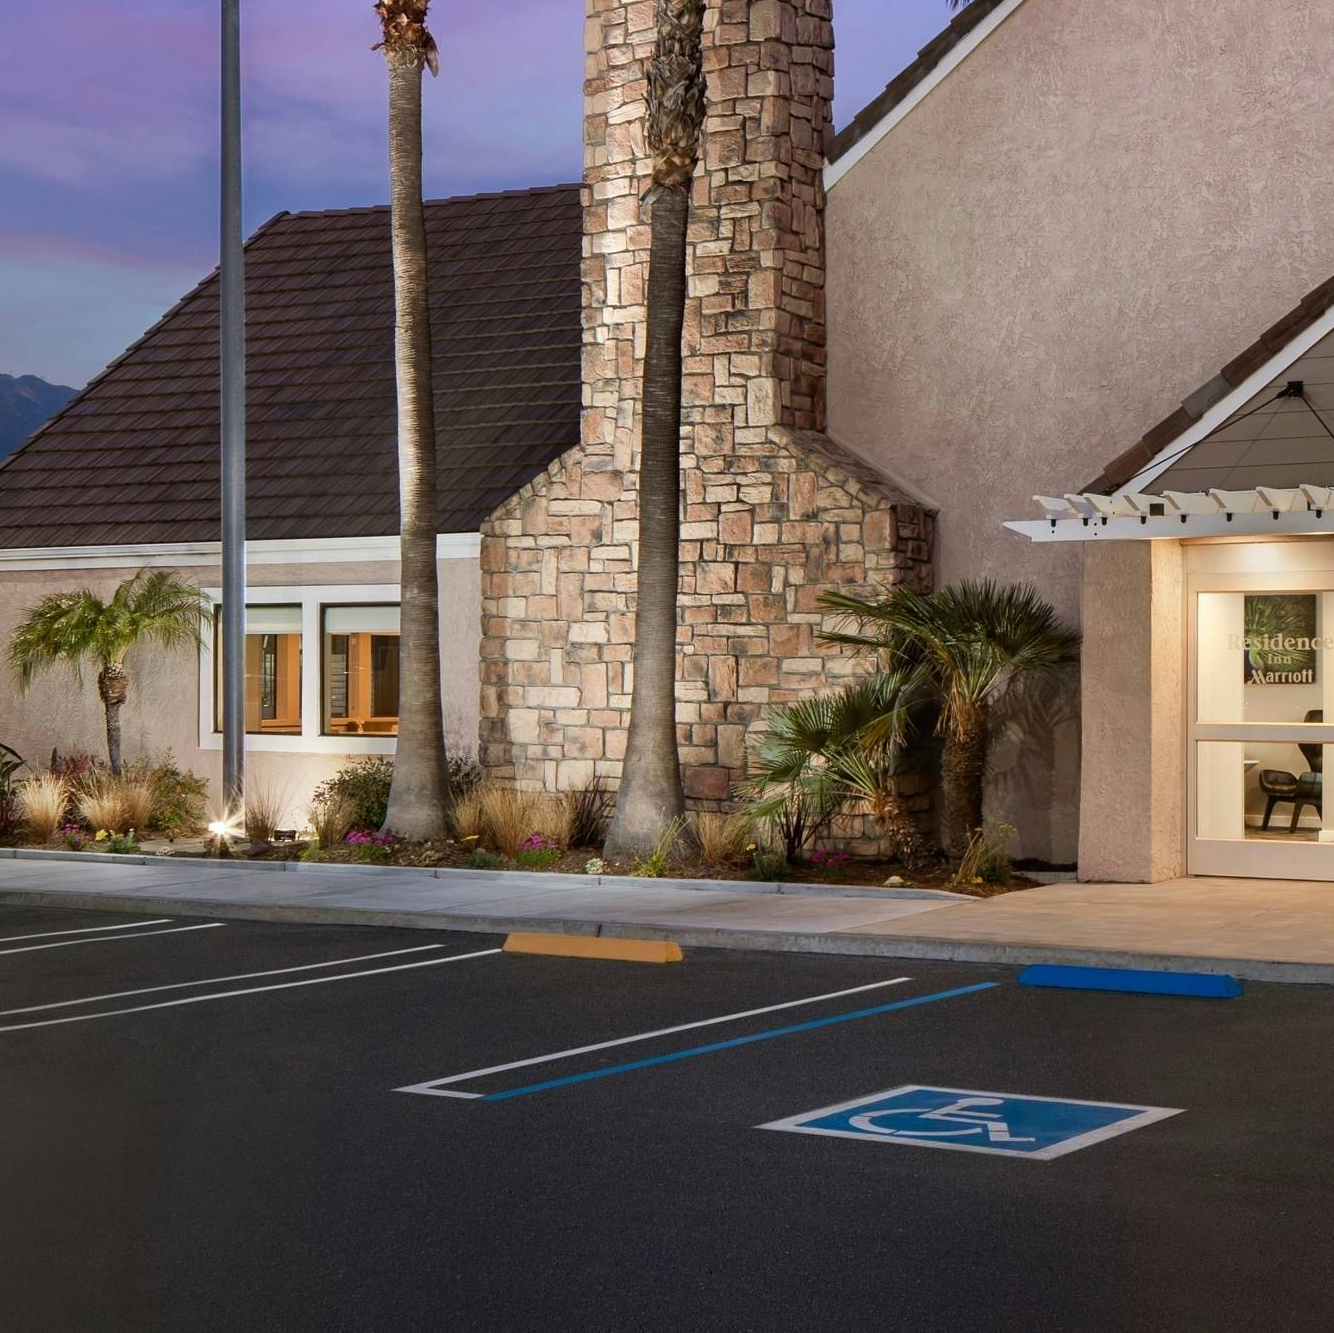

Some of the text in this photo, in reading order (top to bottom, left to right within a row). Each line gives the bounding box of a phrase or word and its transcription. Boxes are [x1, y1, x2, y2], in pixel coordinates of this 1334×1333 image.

[1227, 633, 1334, 651] Residence
[1267, 653, 1292, 665] Inn
[1248, 668, 1314, 684] Marriott
